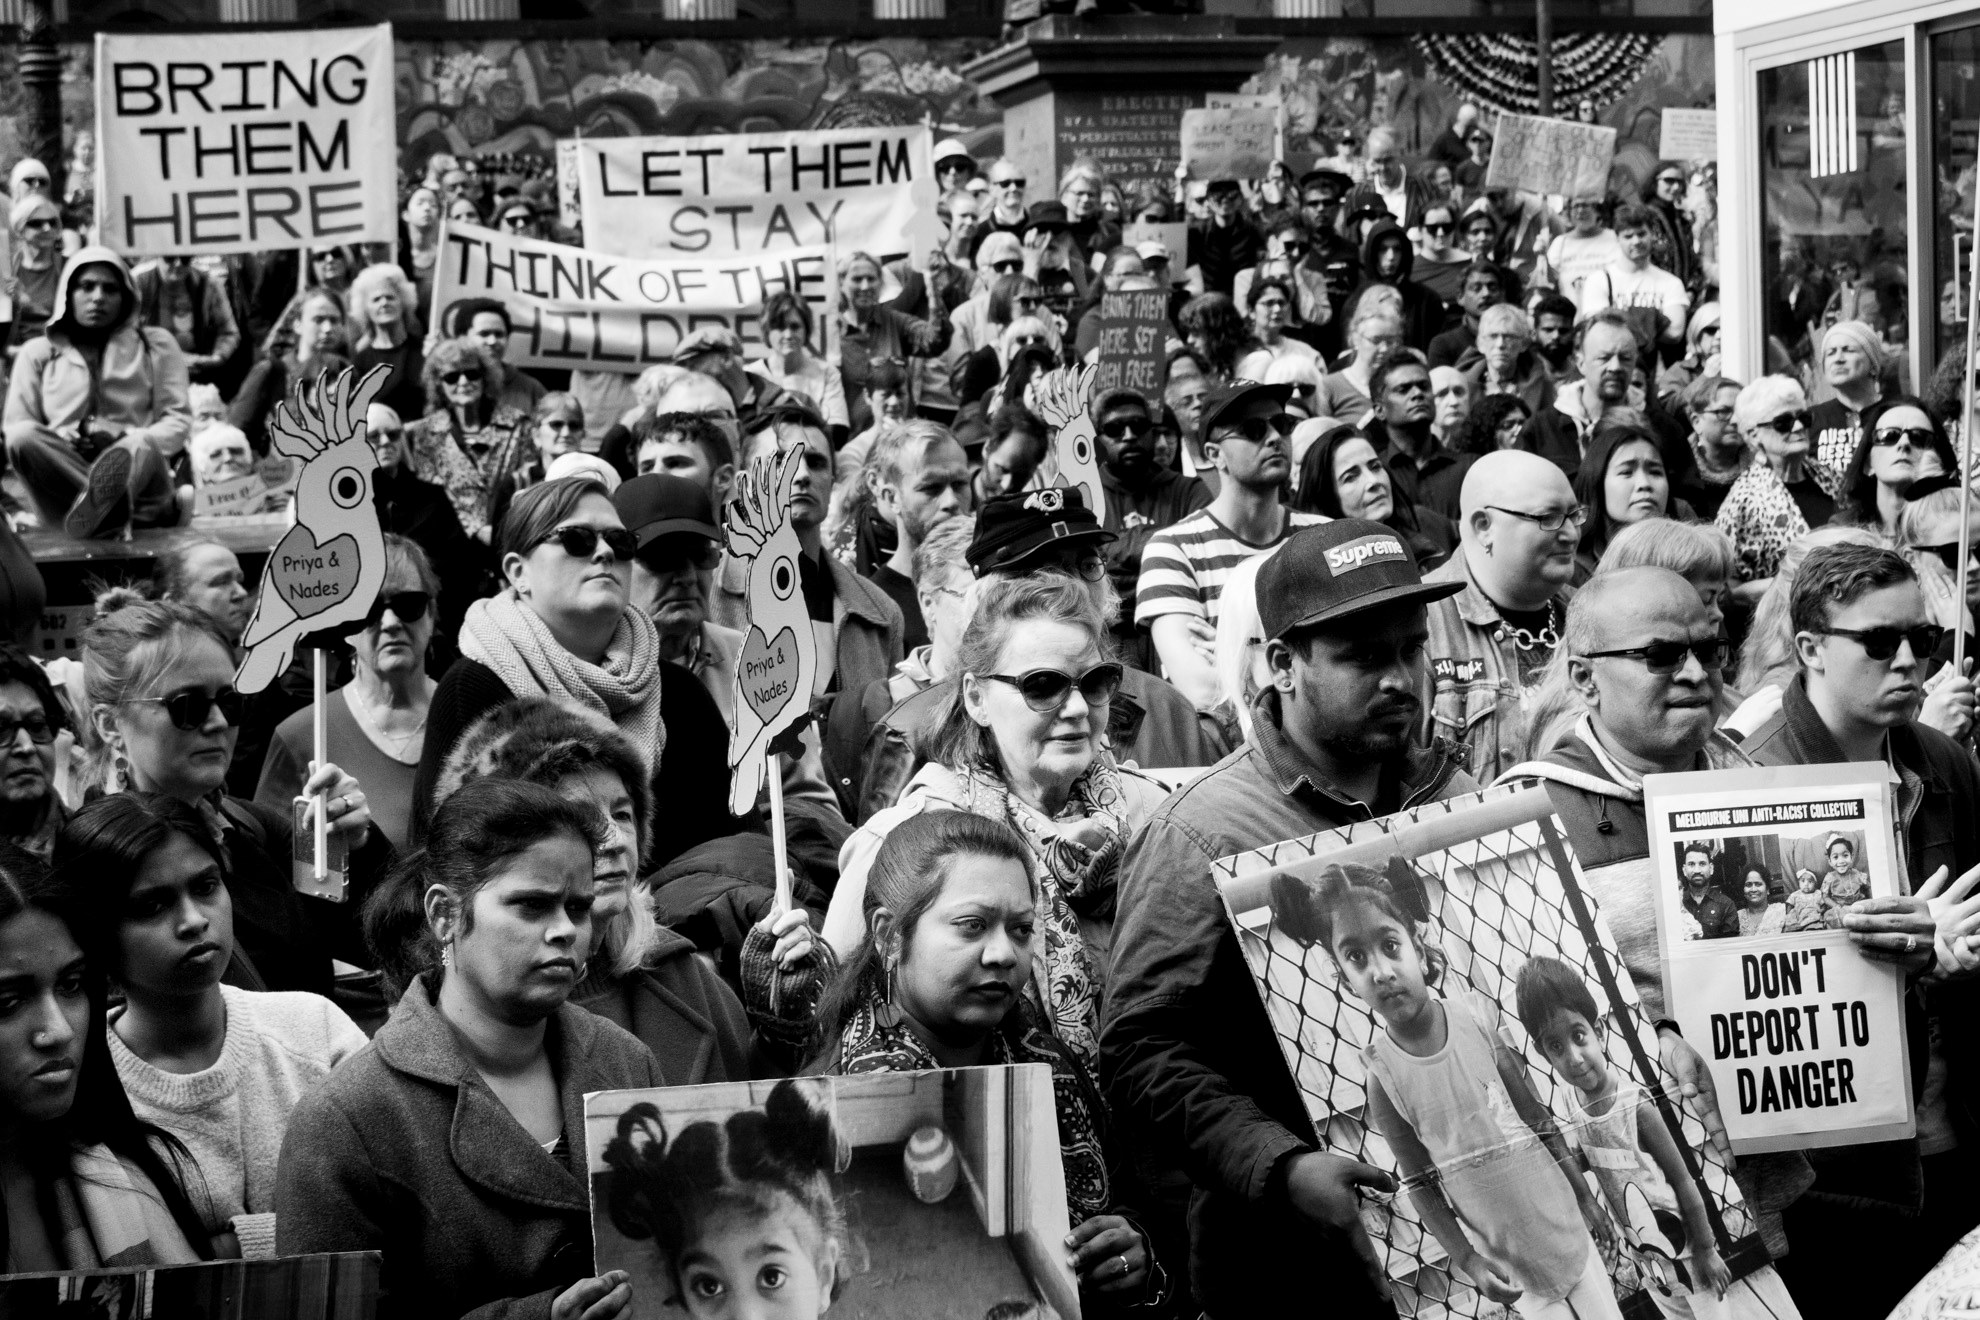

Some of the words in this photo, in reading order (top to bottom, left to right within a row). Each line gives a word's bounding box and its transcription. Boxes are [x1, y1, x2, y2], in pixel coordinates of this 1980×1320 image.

[113, 54, 367, 117] BRING
[139, 119, 349, 180] THEM
[598, 148, 724, 197] LET
[748, 138, 912, 193] THEM
[124, 180, 364, 247] HERE
[669, 199, 845, 251] STAY
[448, 233, 622, 301] THINK
[638, 269, 707, 303] OF
[719, 255, 827, 308] THE
[1134, 292, 1167, 320] THEM
[283, 554, 324, 575] Priya
[329, 551, 340, 567] &
[1328, 540, 1404, 568] Supreme
[289, 580, 339, 600] Nades
[746, 656, 775, 680] Priya
[777, 647, 785, 664] &
[753, 680, 788, 707] Nades
[1675, 809, 1731, 828] MELBOURNE
[1732, 808, 1749, 824] UNI
[1751, 804, 1808, 823] ANTI-RACIST
[1810, 801, 1859, 819] COLLECTIVE
[1741, 947, 1826, 1000] DON'T
[1710, 1004, 1820, 1060] DEPORT
[1832, 1000, 1870, 1048] TO
[1736, 1058, 1858, 1115] DANGER
